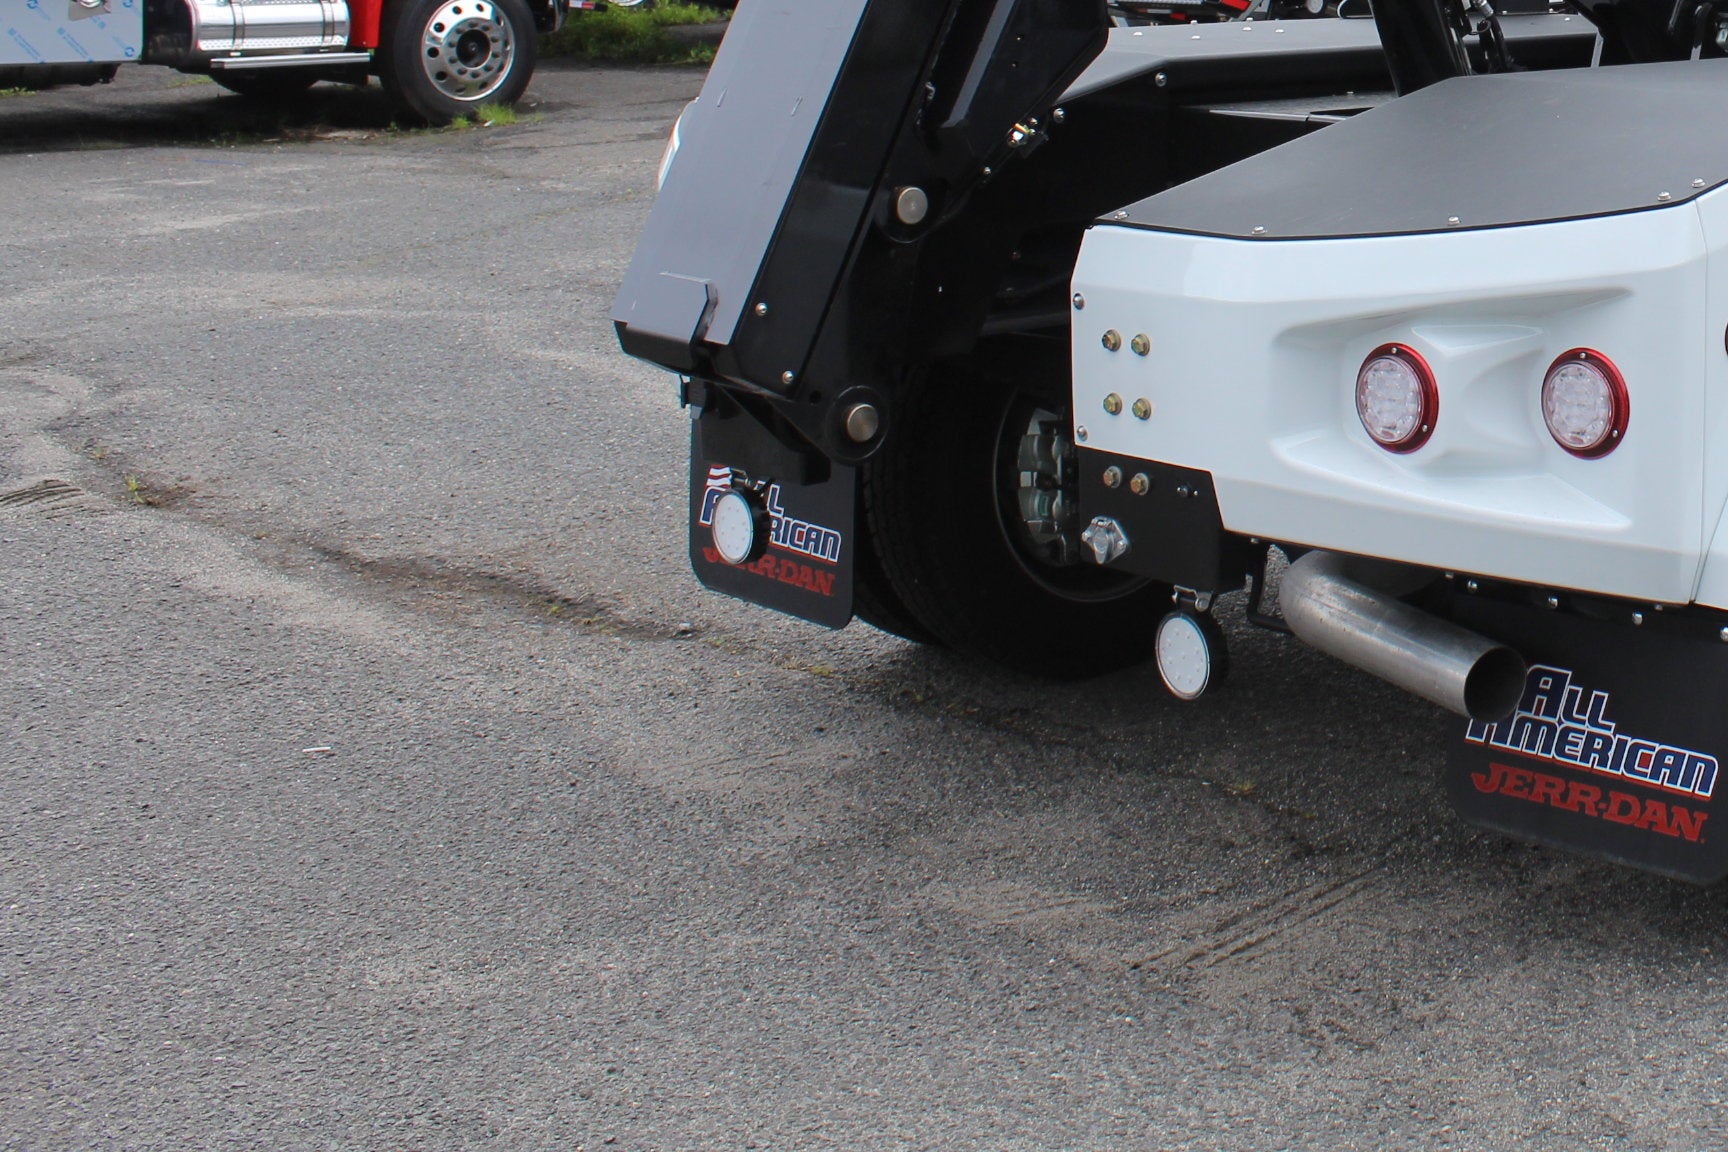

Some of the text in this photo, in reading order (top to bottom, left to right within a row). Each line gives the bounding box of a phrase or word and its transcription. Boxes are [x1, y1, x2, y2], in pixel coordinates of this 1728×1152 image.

[700, 486, 842, 564] ARICAN
[703, 545, 836, 597] JR-DAN
[1517, 664, 1615, 734] ALL
[1471, 762, 1709, 843] JERR-DAN
